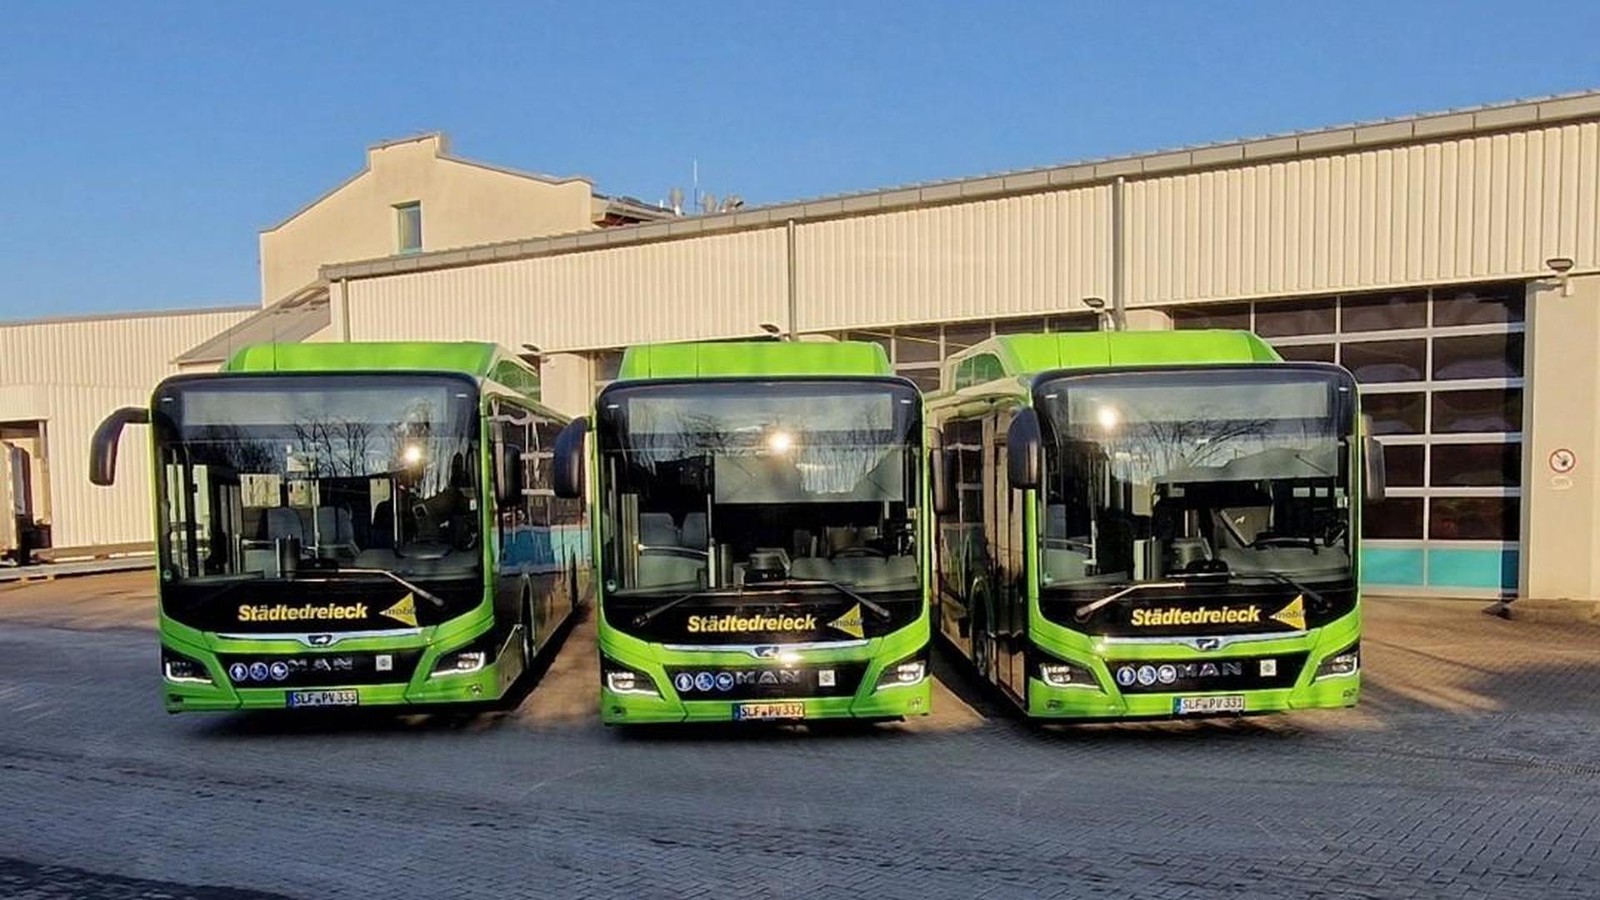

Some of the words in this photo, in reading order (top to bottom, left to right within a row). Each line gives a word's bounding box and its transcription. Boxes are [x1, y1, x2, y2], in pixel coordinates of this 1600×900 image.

[238, 603, 367, 621] Städtedreieck
[1131, 606, 1260, 626] Städtedreieck
[688, 614, 816, 632] Städtedreieck
[287, 659, 353, 672] MAN
[1180, 663, 1242, 678] MAN
[736, 671, 801, 684] MAN
[294, 692, 315, 704] SLF
[1183, 699, 1204, 710] SLF
[741, 707, 762, 717] SLF
